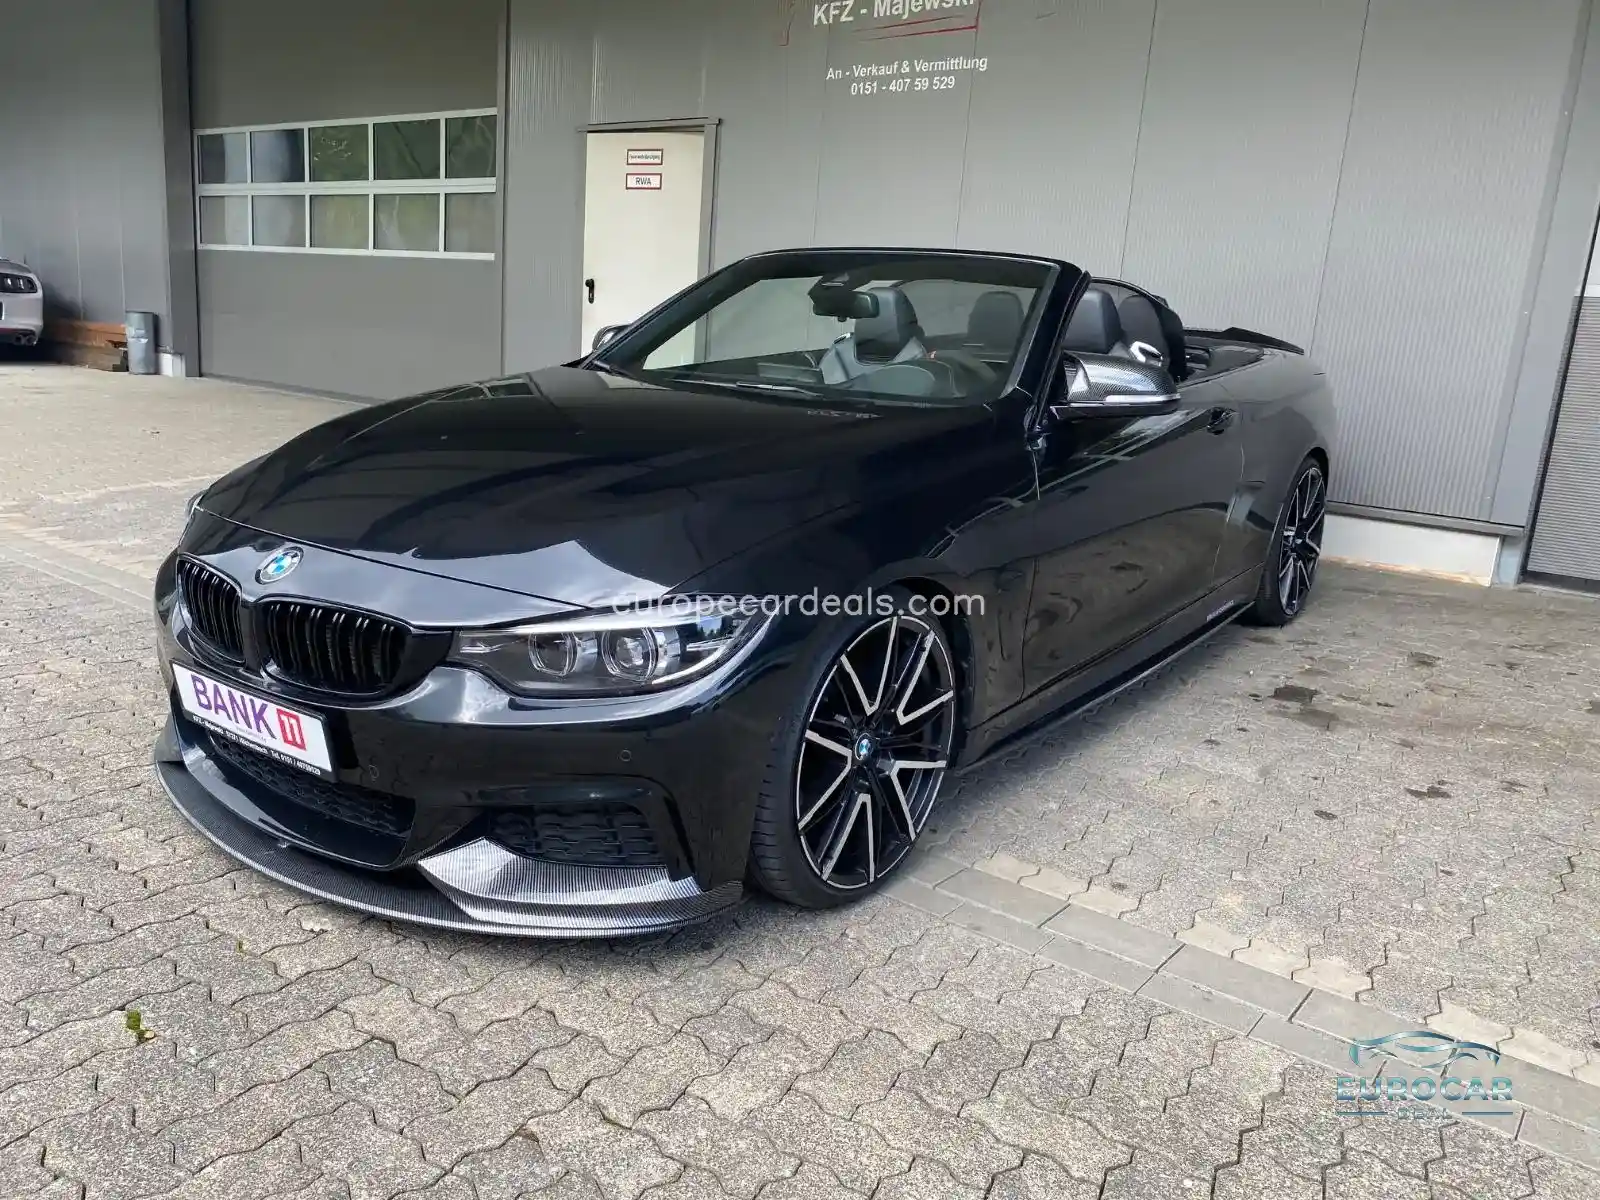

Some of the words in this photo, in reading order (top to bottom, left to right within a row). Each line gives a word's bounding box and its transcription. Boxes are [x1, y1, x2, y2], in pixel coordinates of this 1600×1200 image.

[813, 1, 854, 28] KFZ
[873, 0, 974, 20] Majews
[826, 67, 842, 80] An
[852, 61, 898, 78] Verkauf
[900, 60, 910, 74] &
[914, 56, 988, 74] Vermittlung
[851, 81, 877, 96] 0151
[889, 79, 910, 92] 407
[914, 78, 929, 91] 59
[933, 75, 956, 90] 529
[635, 176, 652, 186] RWA
[191, 674, 277, 740] BANK
